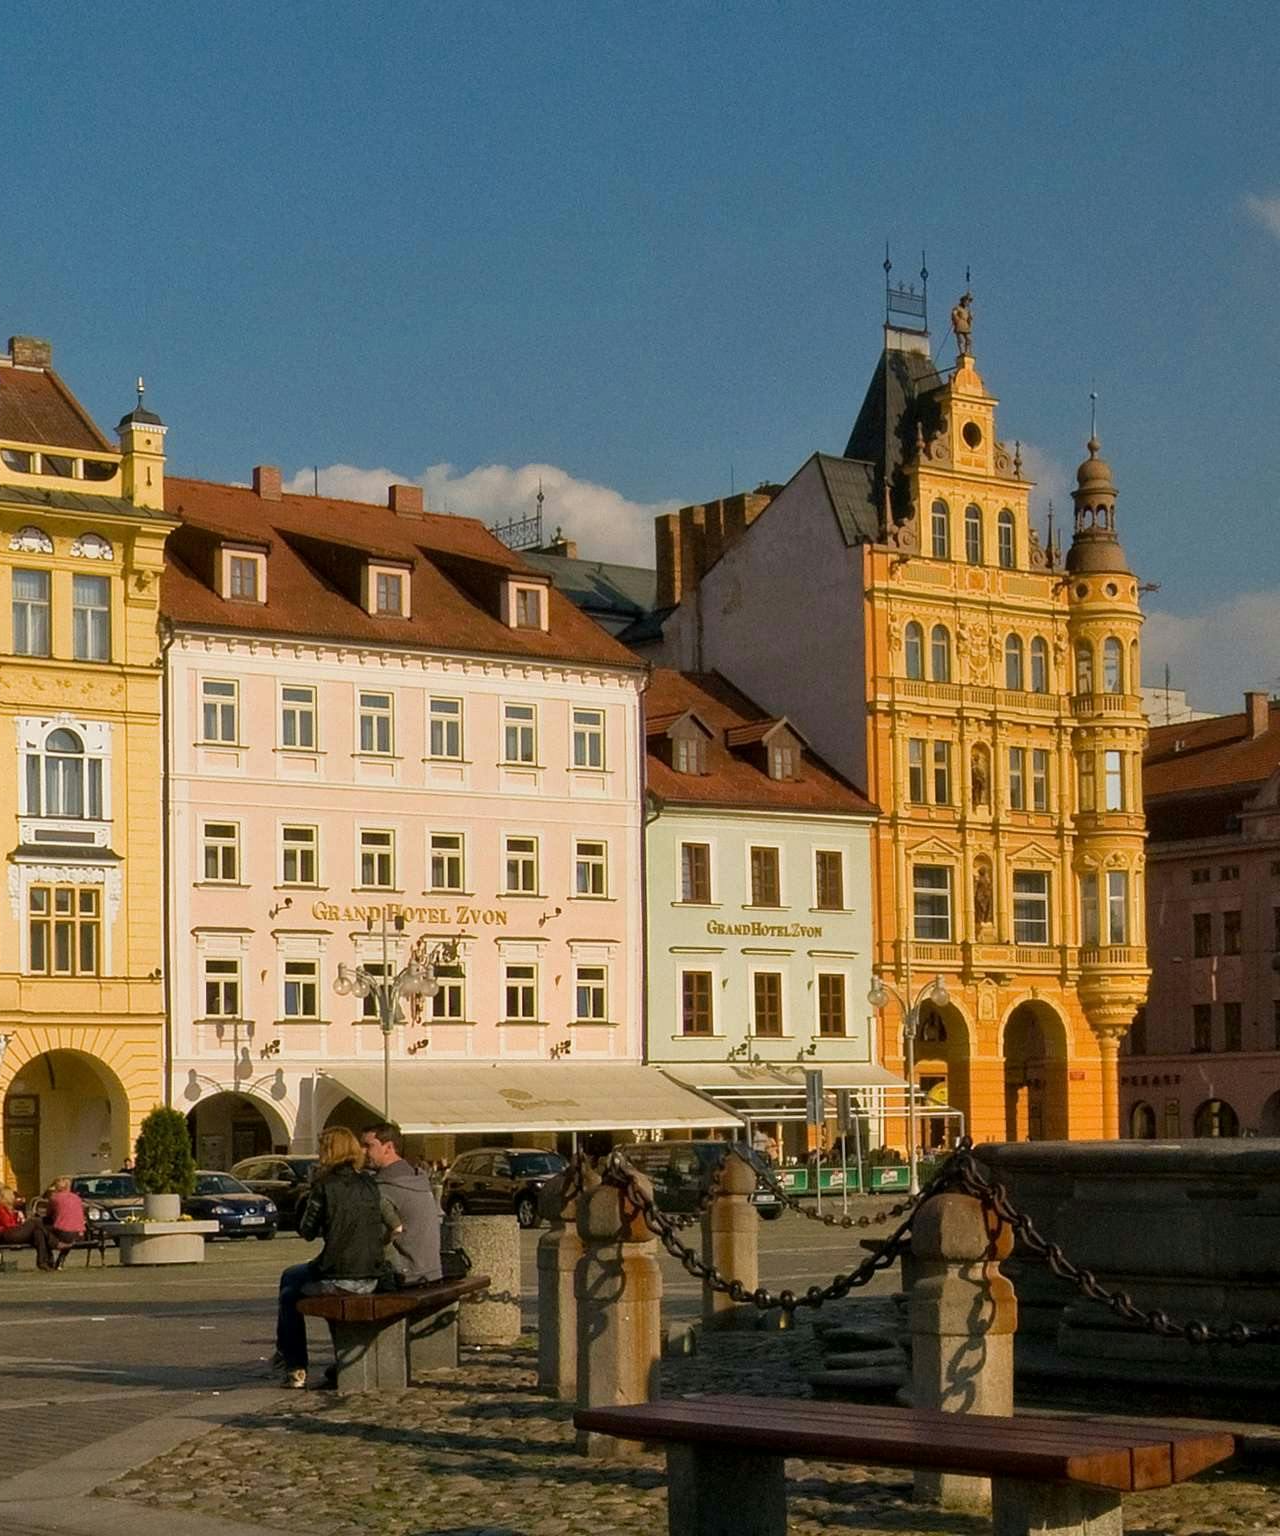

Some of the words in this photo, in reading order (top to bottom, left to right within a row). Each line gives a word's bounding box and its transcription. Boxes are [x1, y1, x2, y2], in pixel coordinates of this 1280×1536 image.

[312, 901, 381, 922] GRAND
[386, 903, 451, 924] HOTEL
[456, 906, 507, 926] ZVON
